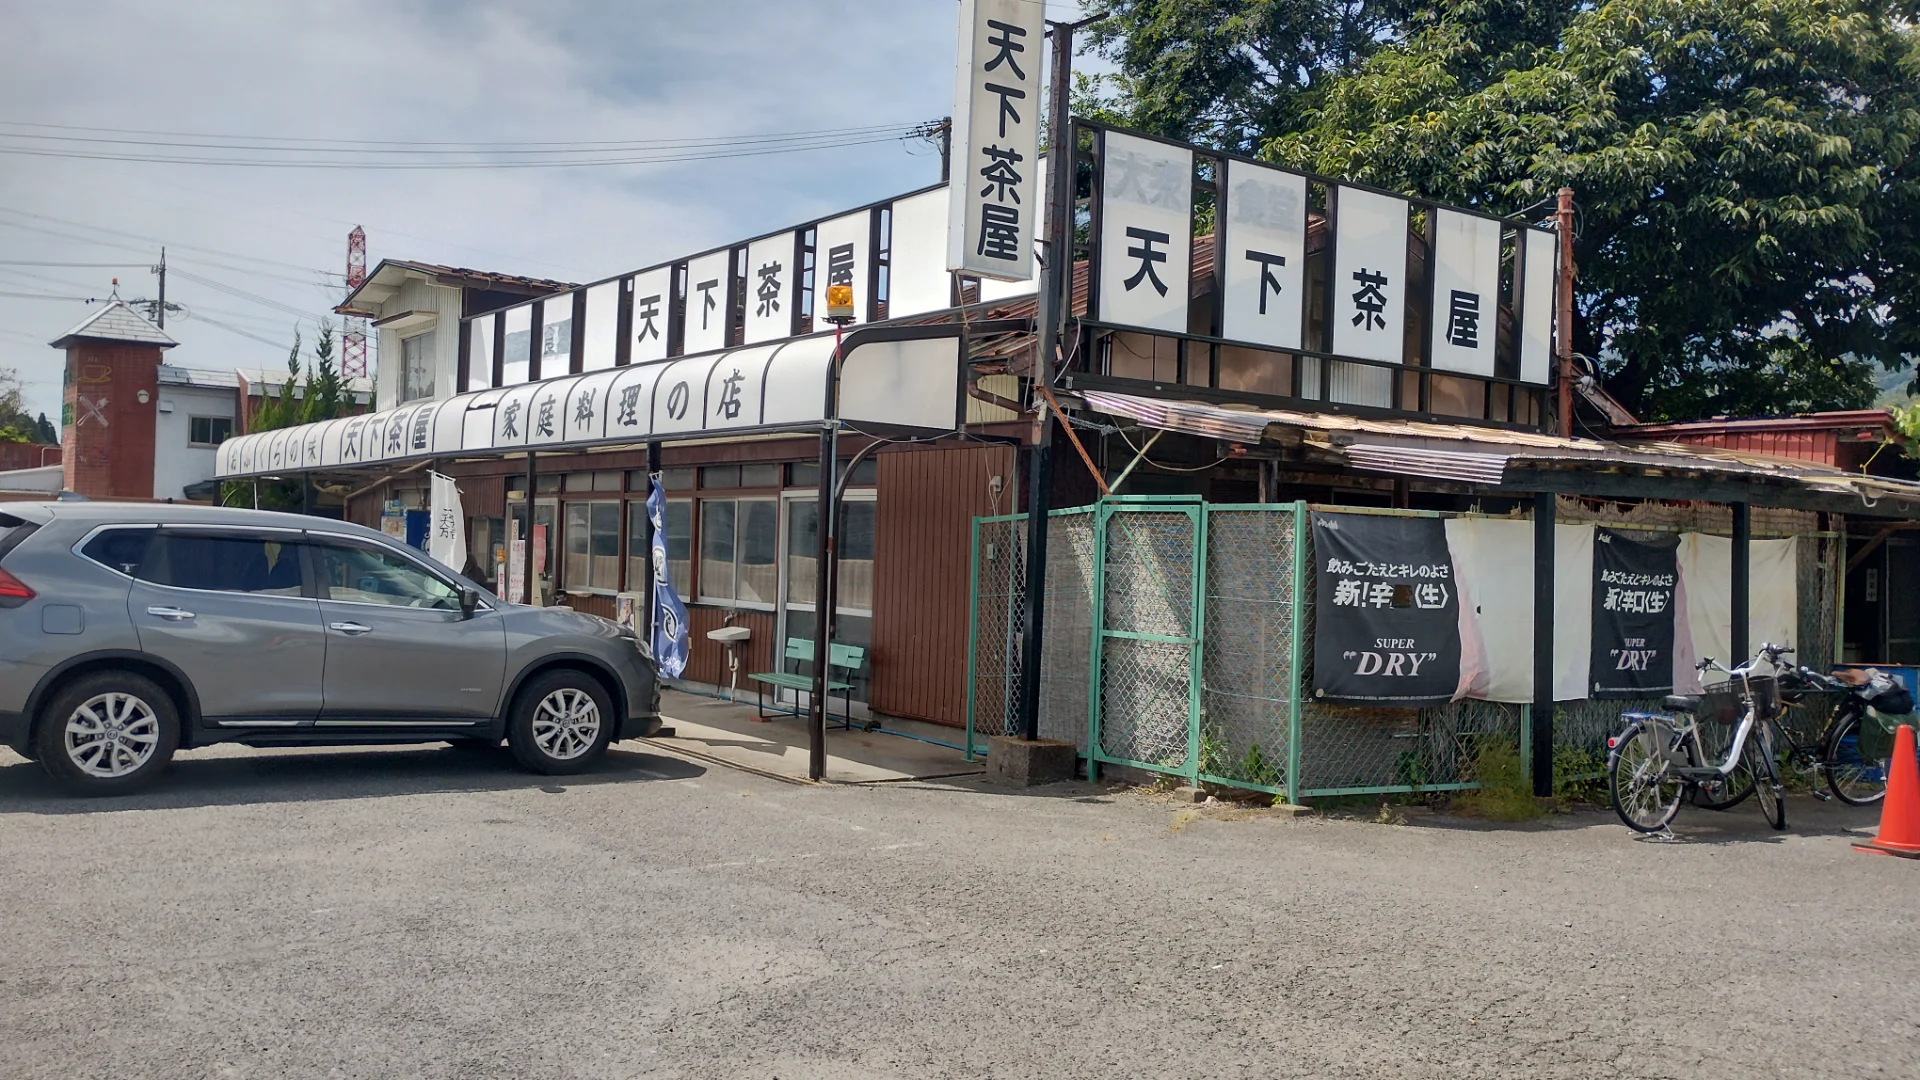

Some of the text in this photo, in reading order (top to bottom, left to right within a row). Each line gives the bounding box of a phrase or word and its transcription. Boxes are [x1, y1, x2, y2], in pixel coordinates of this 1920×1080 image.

[977, 19, 1027, 262] 天下茶屋
[1123, 226, 1480, 349] 天下茶屋
[344, 407, 436, 459] 天下茶屋
[501, 368, 746, 440] 家庭料理の店
[1326, 557, 1449, 579] 飲みごたえとキレのよさ
[1333, 578, 1449, 610] 新!辛〈生〉
[1374, 638, 1415, 649] SUPER
